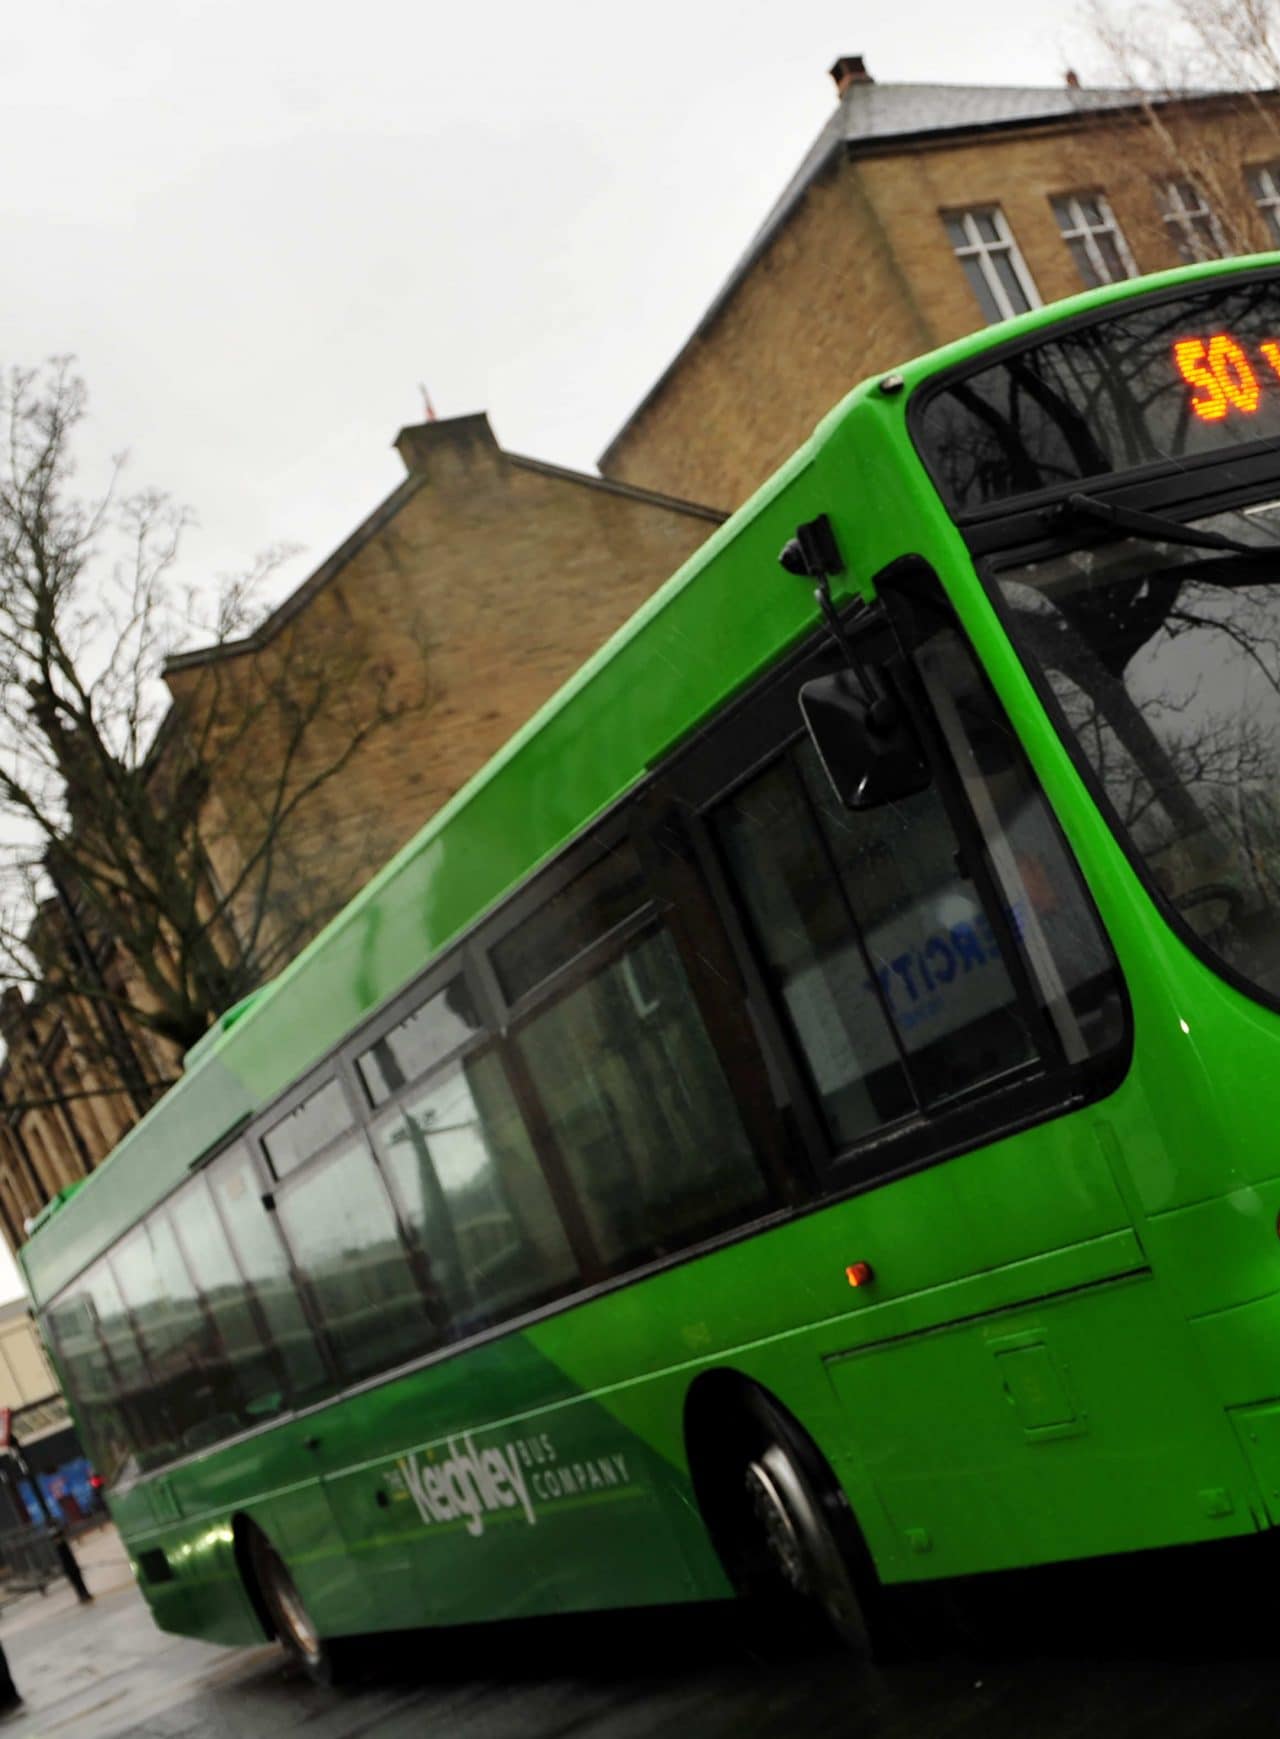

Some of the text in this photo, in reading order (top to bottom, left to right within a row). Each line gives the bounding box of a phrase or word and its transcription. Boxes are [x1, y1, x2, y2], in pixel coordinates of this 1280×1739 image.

[1174, 335, 1260, 420] 50
[517, 1433, 556, 1468] BUS
[532, 1453, 630, 1499] COMPANY
[401, 1431, 536, 1536] Keighley
